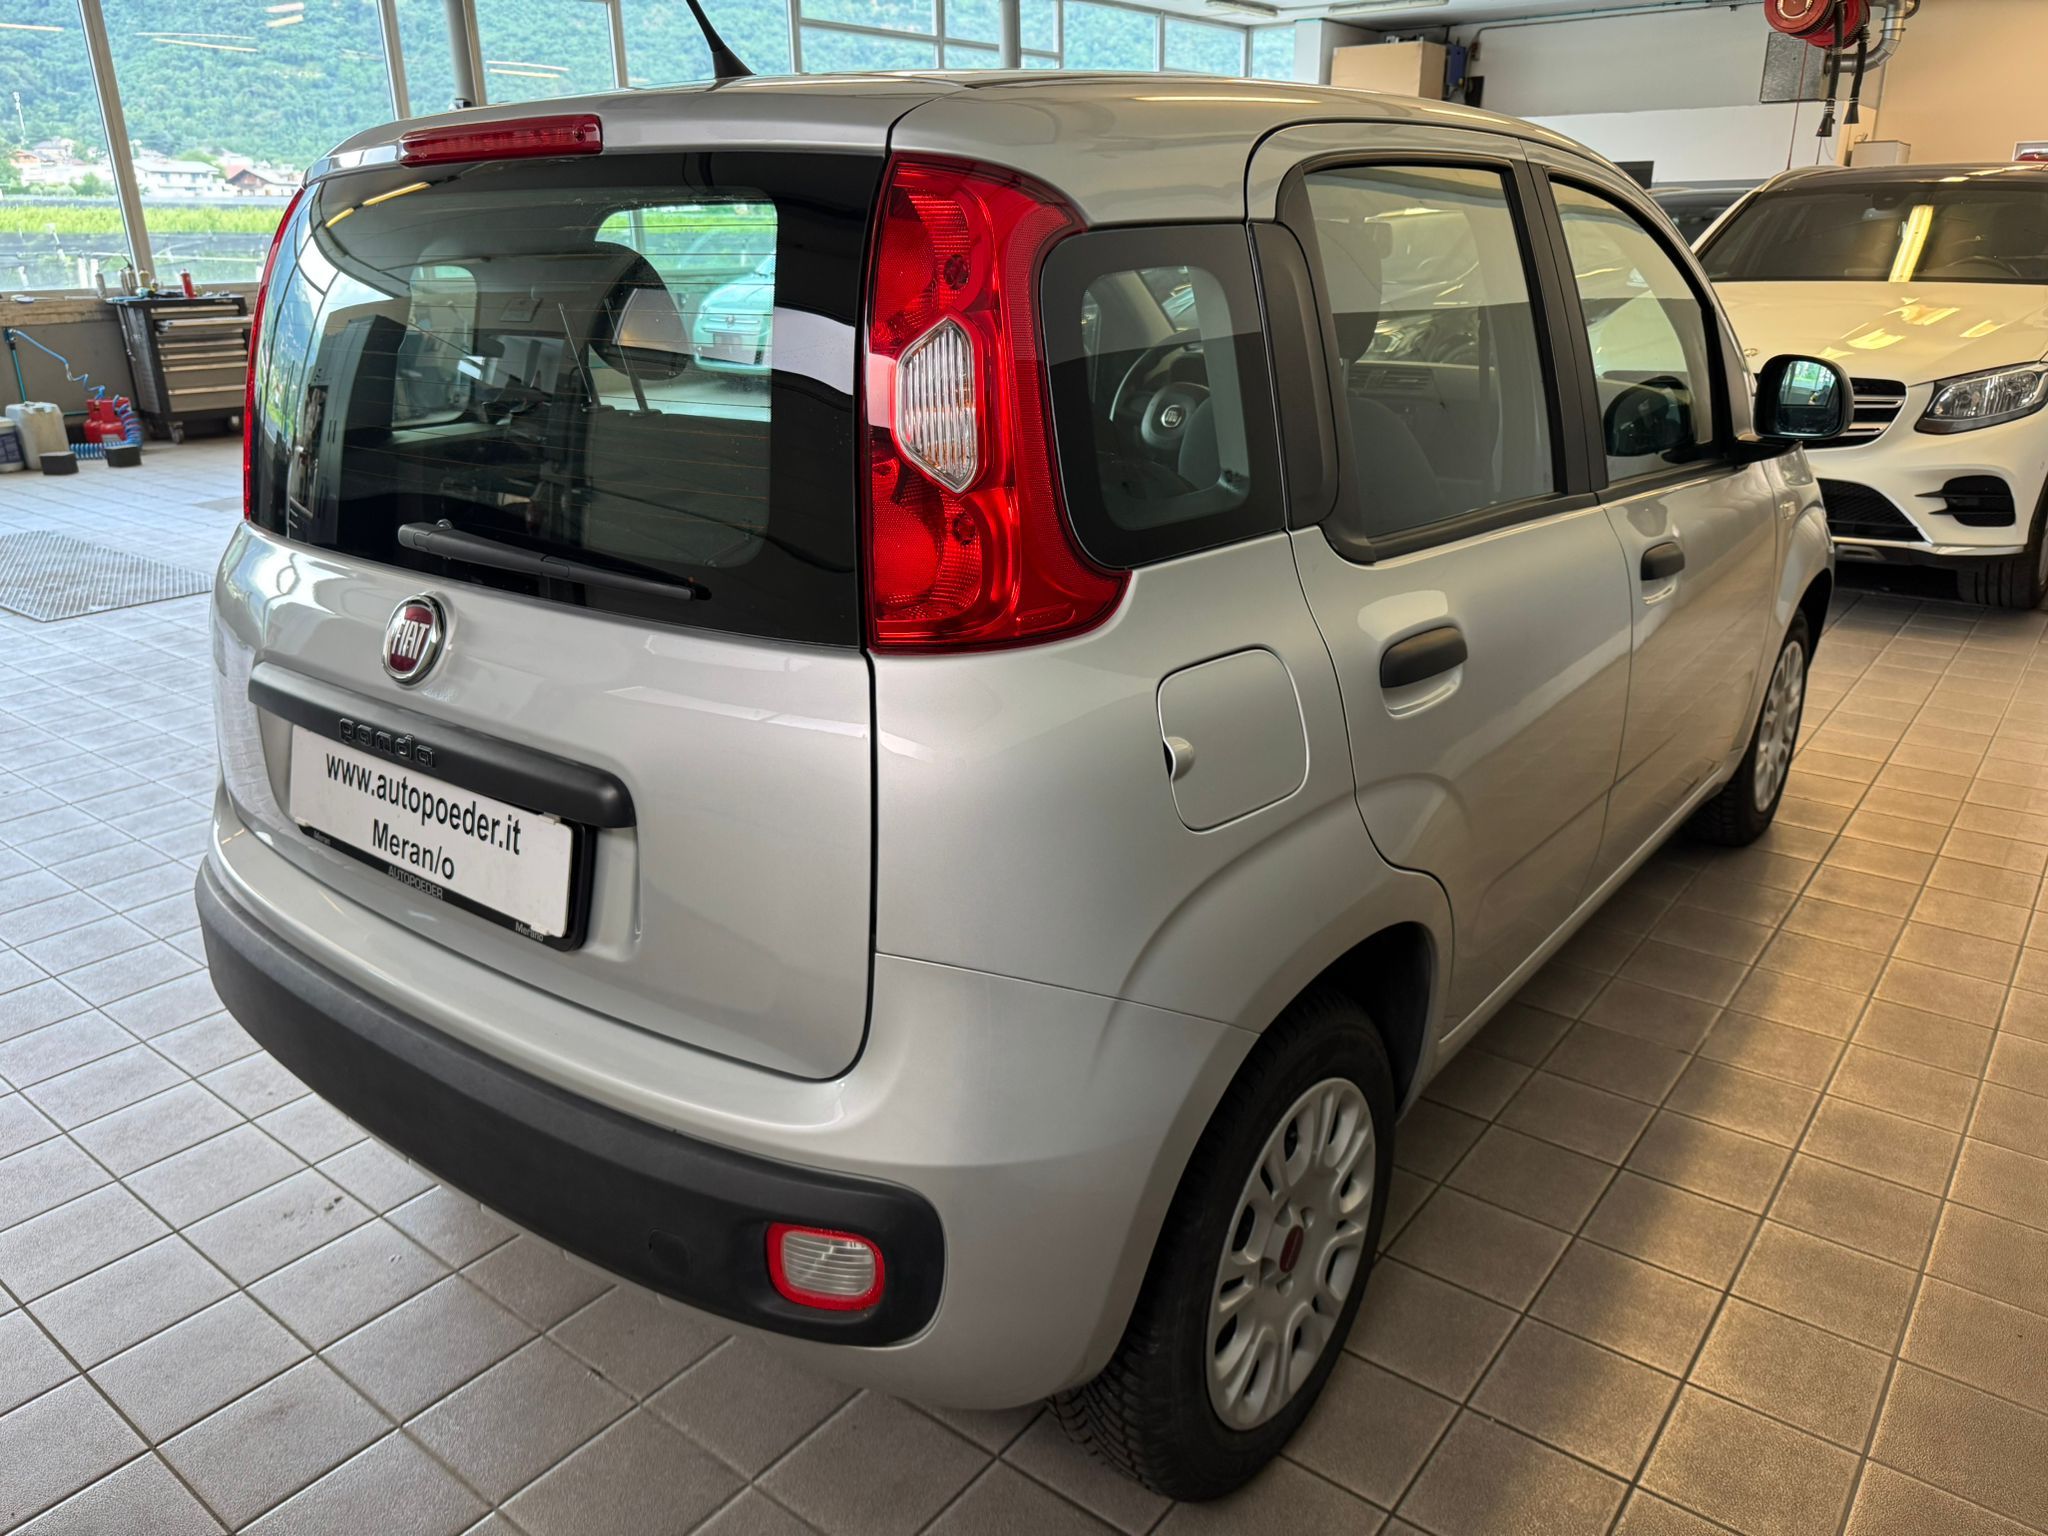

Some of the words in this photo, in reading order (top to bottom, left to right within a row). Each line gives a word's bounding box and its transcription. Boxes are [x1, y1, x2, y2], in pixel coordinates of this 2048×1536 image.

[391, 619, 430, 660] FIAT
[340, 718, 435, 768] panda
[325, 752, 521, 855] www.autopoeder.it
[372, 818, 455, 880] Meran/o
[388, 865, 443, 900] AUTOPOEDER
